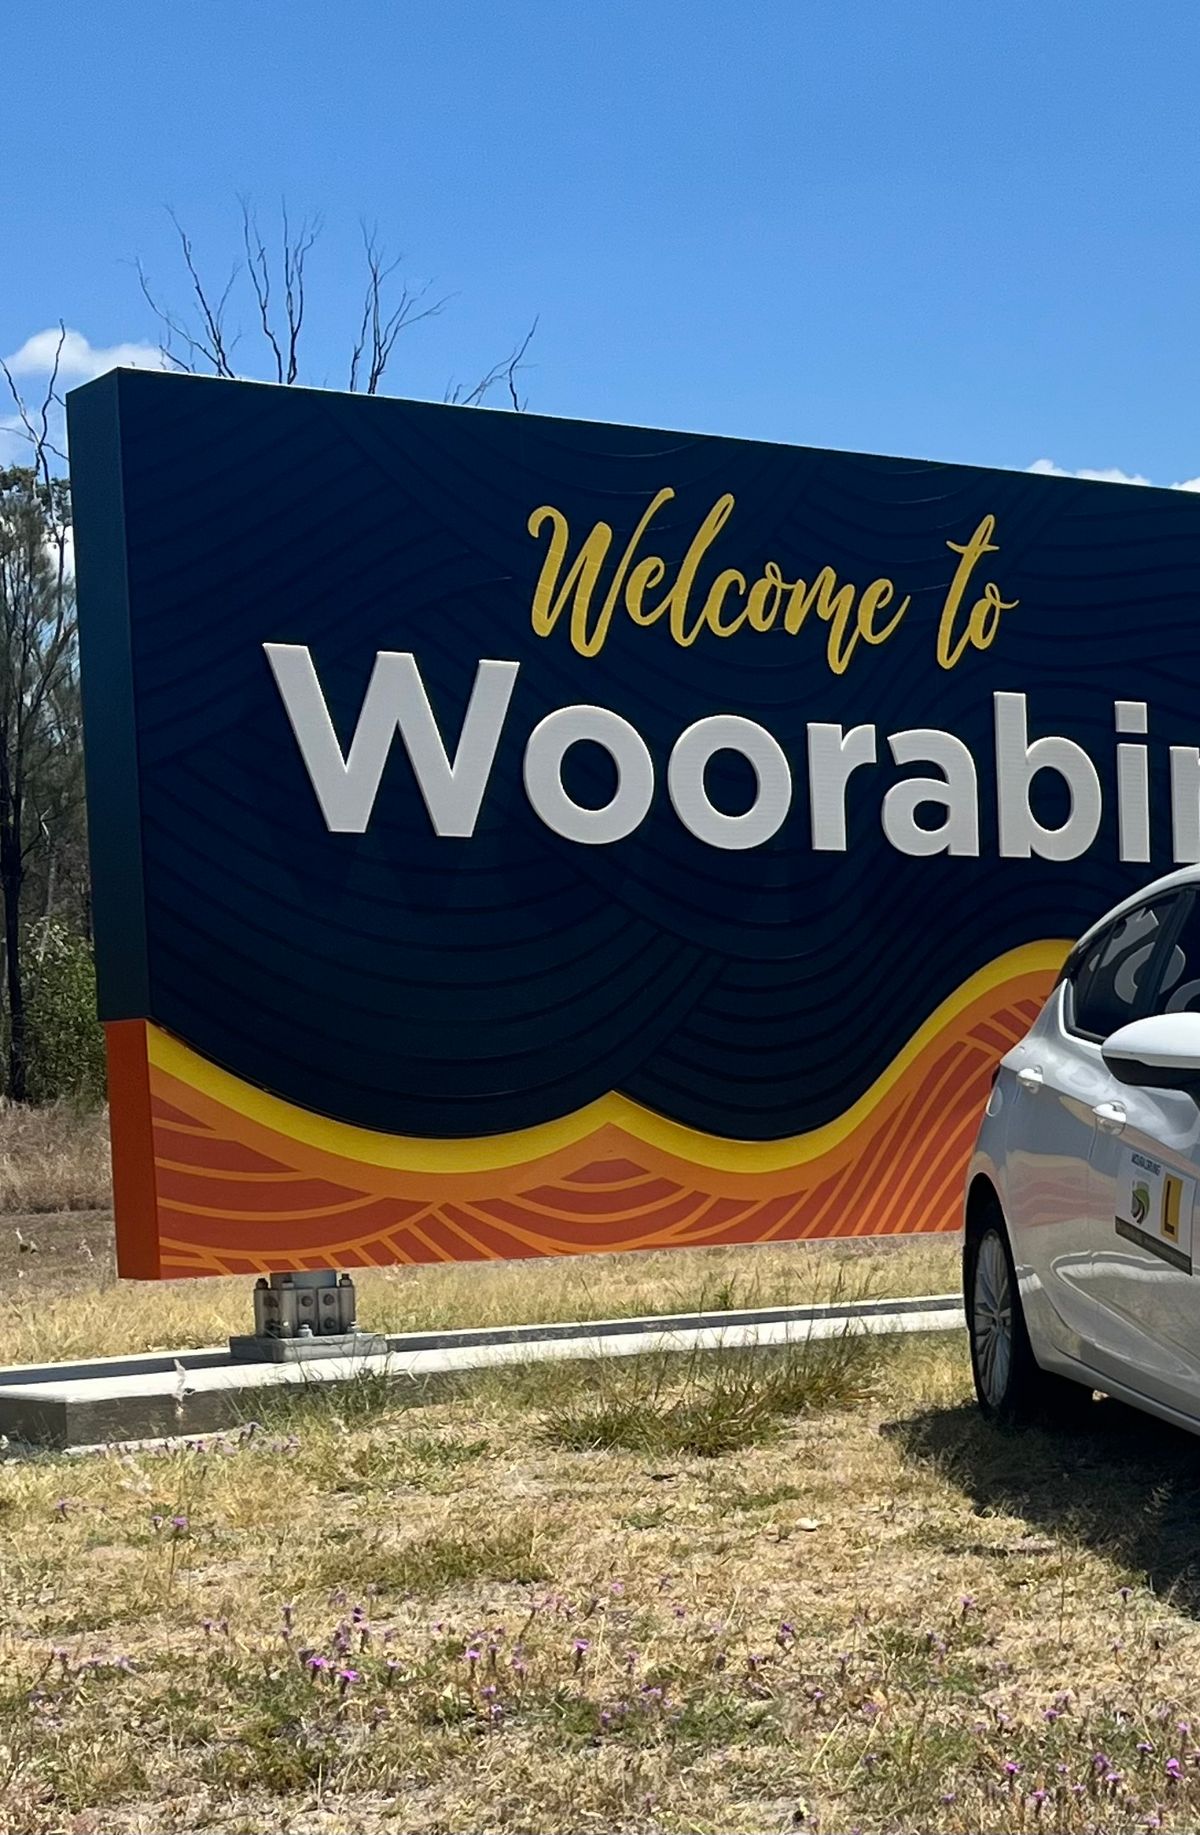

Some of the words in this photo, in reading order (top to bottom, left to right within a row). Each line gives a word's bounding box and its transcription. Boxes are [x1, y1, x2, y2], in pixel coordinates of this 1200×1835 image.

[528, 487, 911, 674] Welcome
[937, 515, 1020, 669] to
[1164, 1180, 1175, 1235] L
